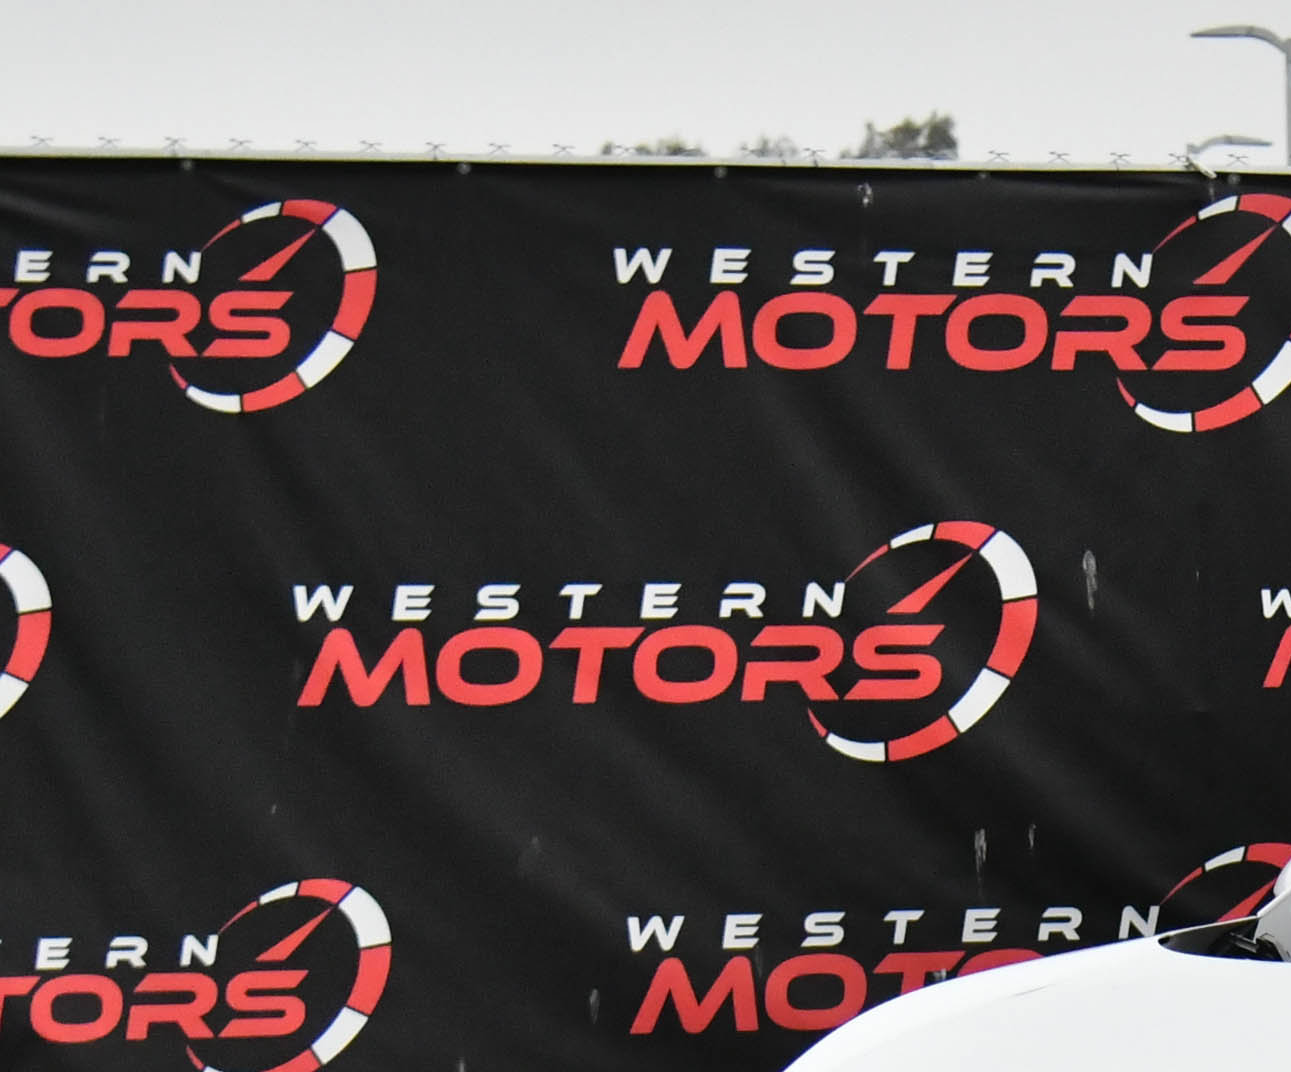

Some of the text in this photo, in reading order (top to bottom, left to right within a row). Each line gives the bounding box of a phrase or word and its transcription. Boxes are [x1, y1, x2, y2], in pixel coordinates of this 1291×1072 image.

[614, 248, 1152, 287] WESTERN
[0, 288, 292, 357] ORS
[618, 291, 1248, 371] MOTORS
[294, 582, 845, 621] WESTERN
[298, 624, 944, 707] MOTORS
[628, 906, 1159, 951] WESTERN
[0, 970, 308, 1043] ORS
[630, 949, 1042, 1034] MOT
